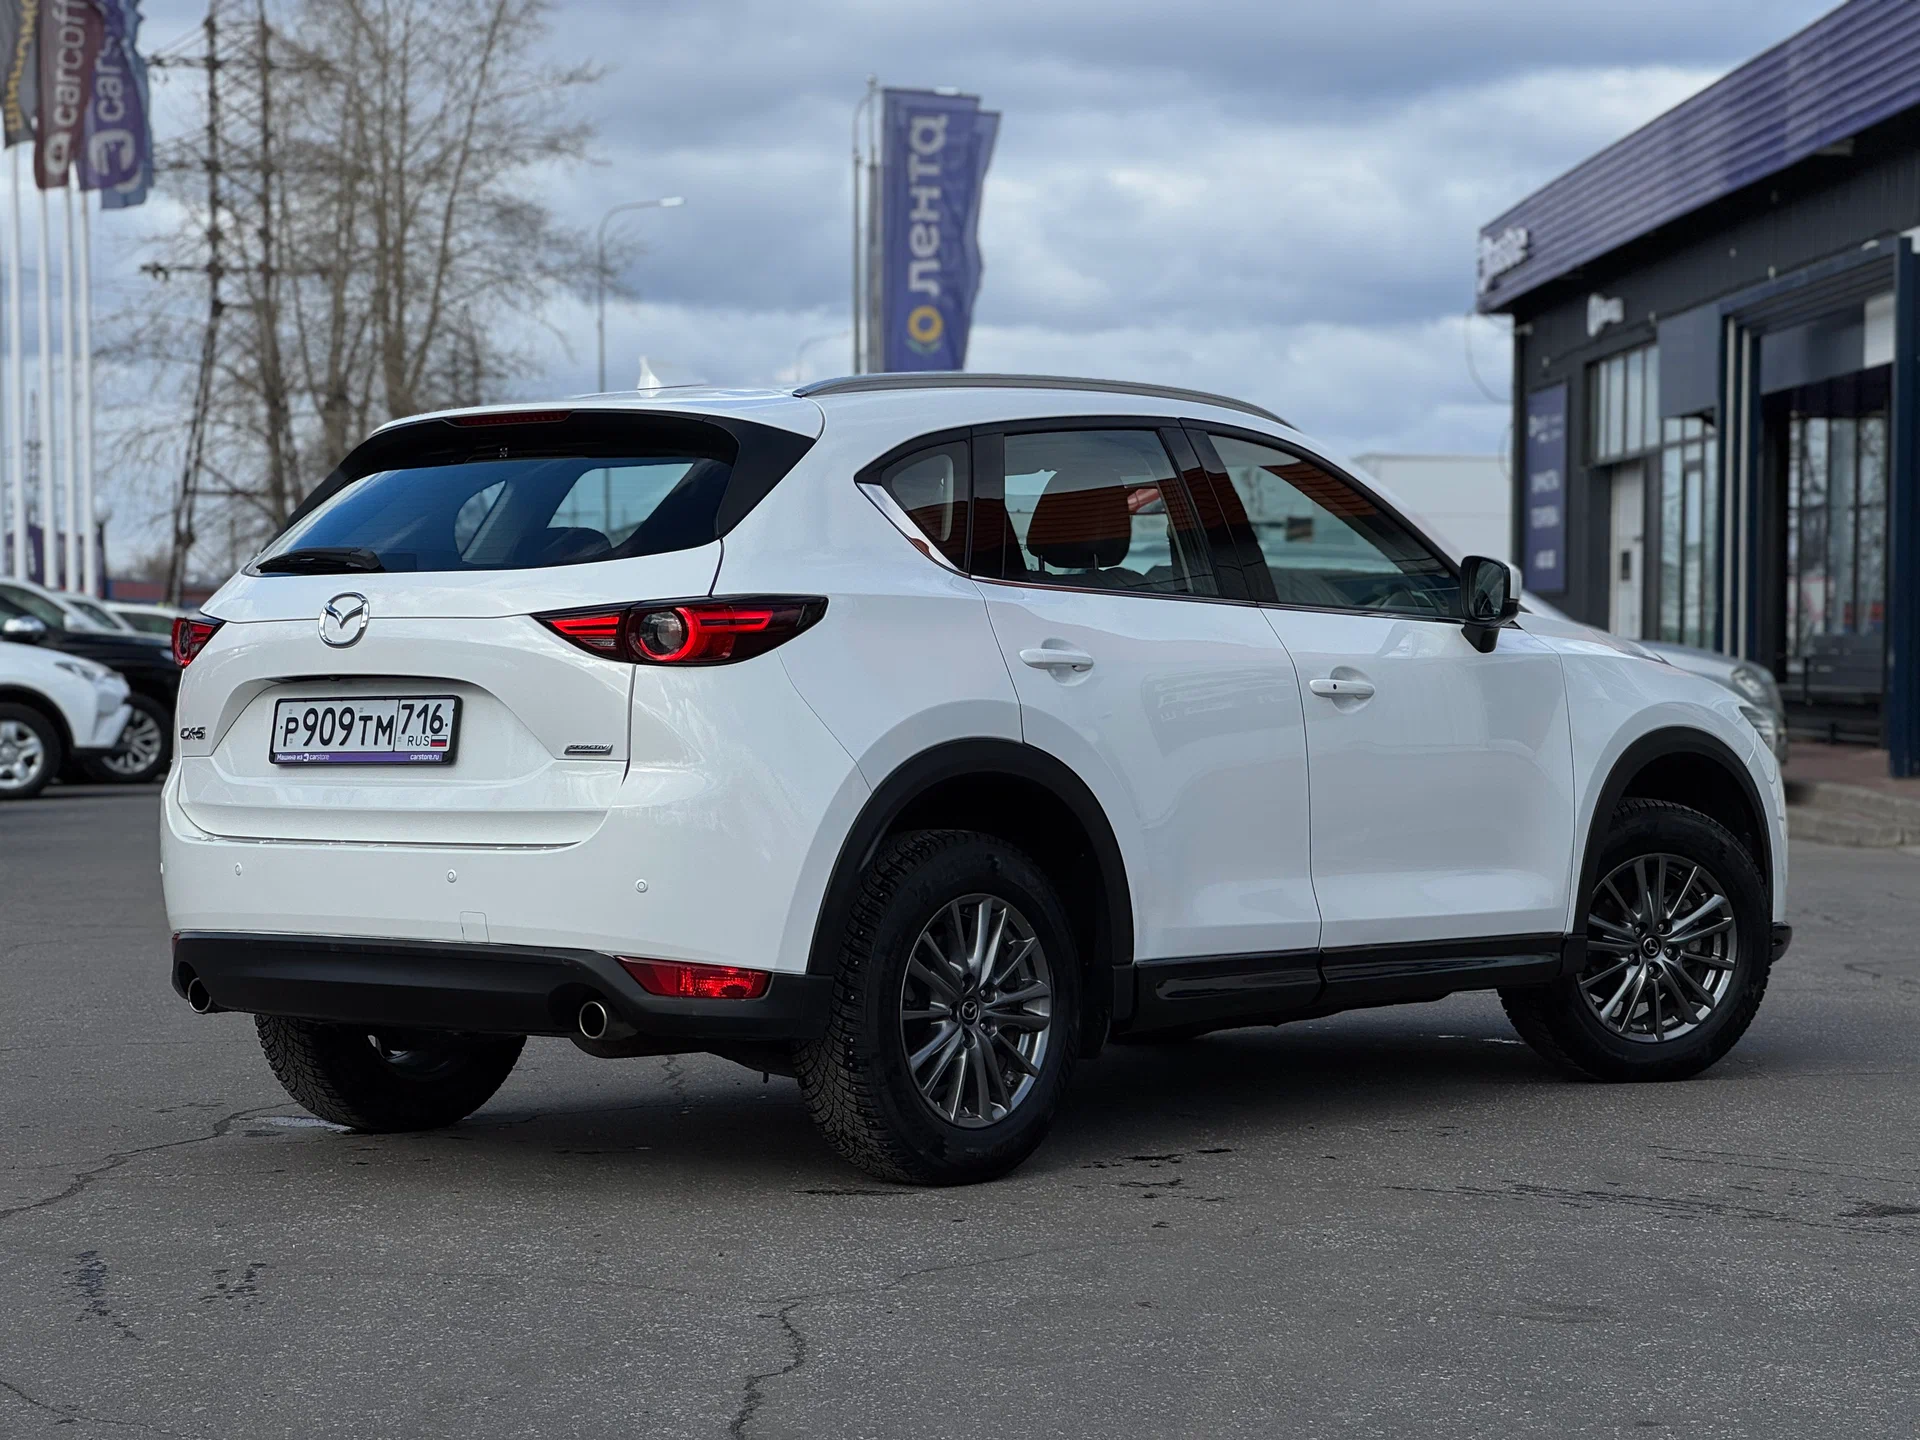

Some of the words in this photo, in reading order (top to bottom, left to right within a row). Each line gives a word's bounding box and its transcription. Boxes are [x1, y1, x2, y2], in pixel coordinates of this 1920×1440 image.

[907, 113, 948, 297] лента
[401, 703, 444, 735] 716
[407, 735, 430, 747] RUS
[409, 753, 440, 761] carstore.ru
